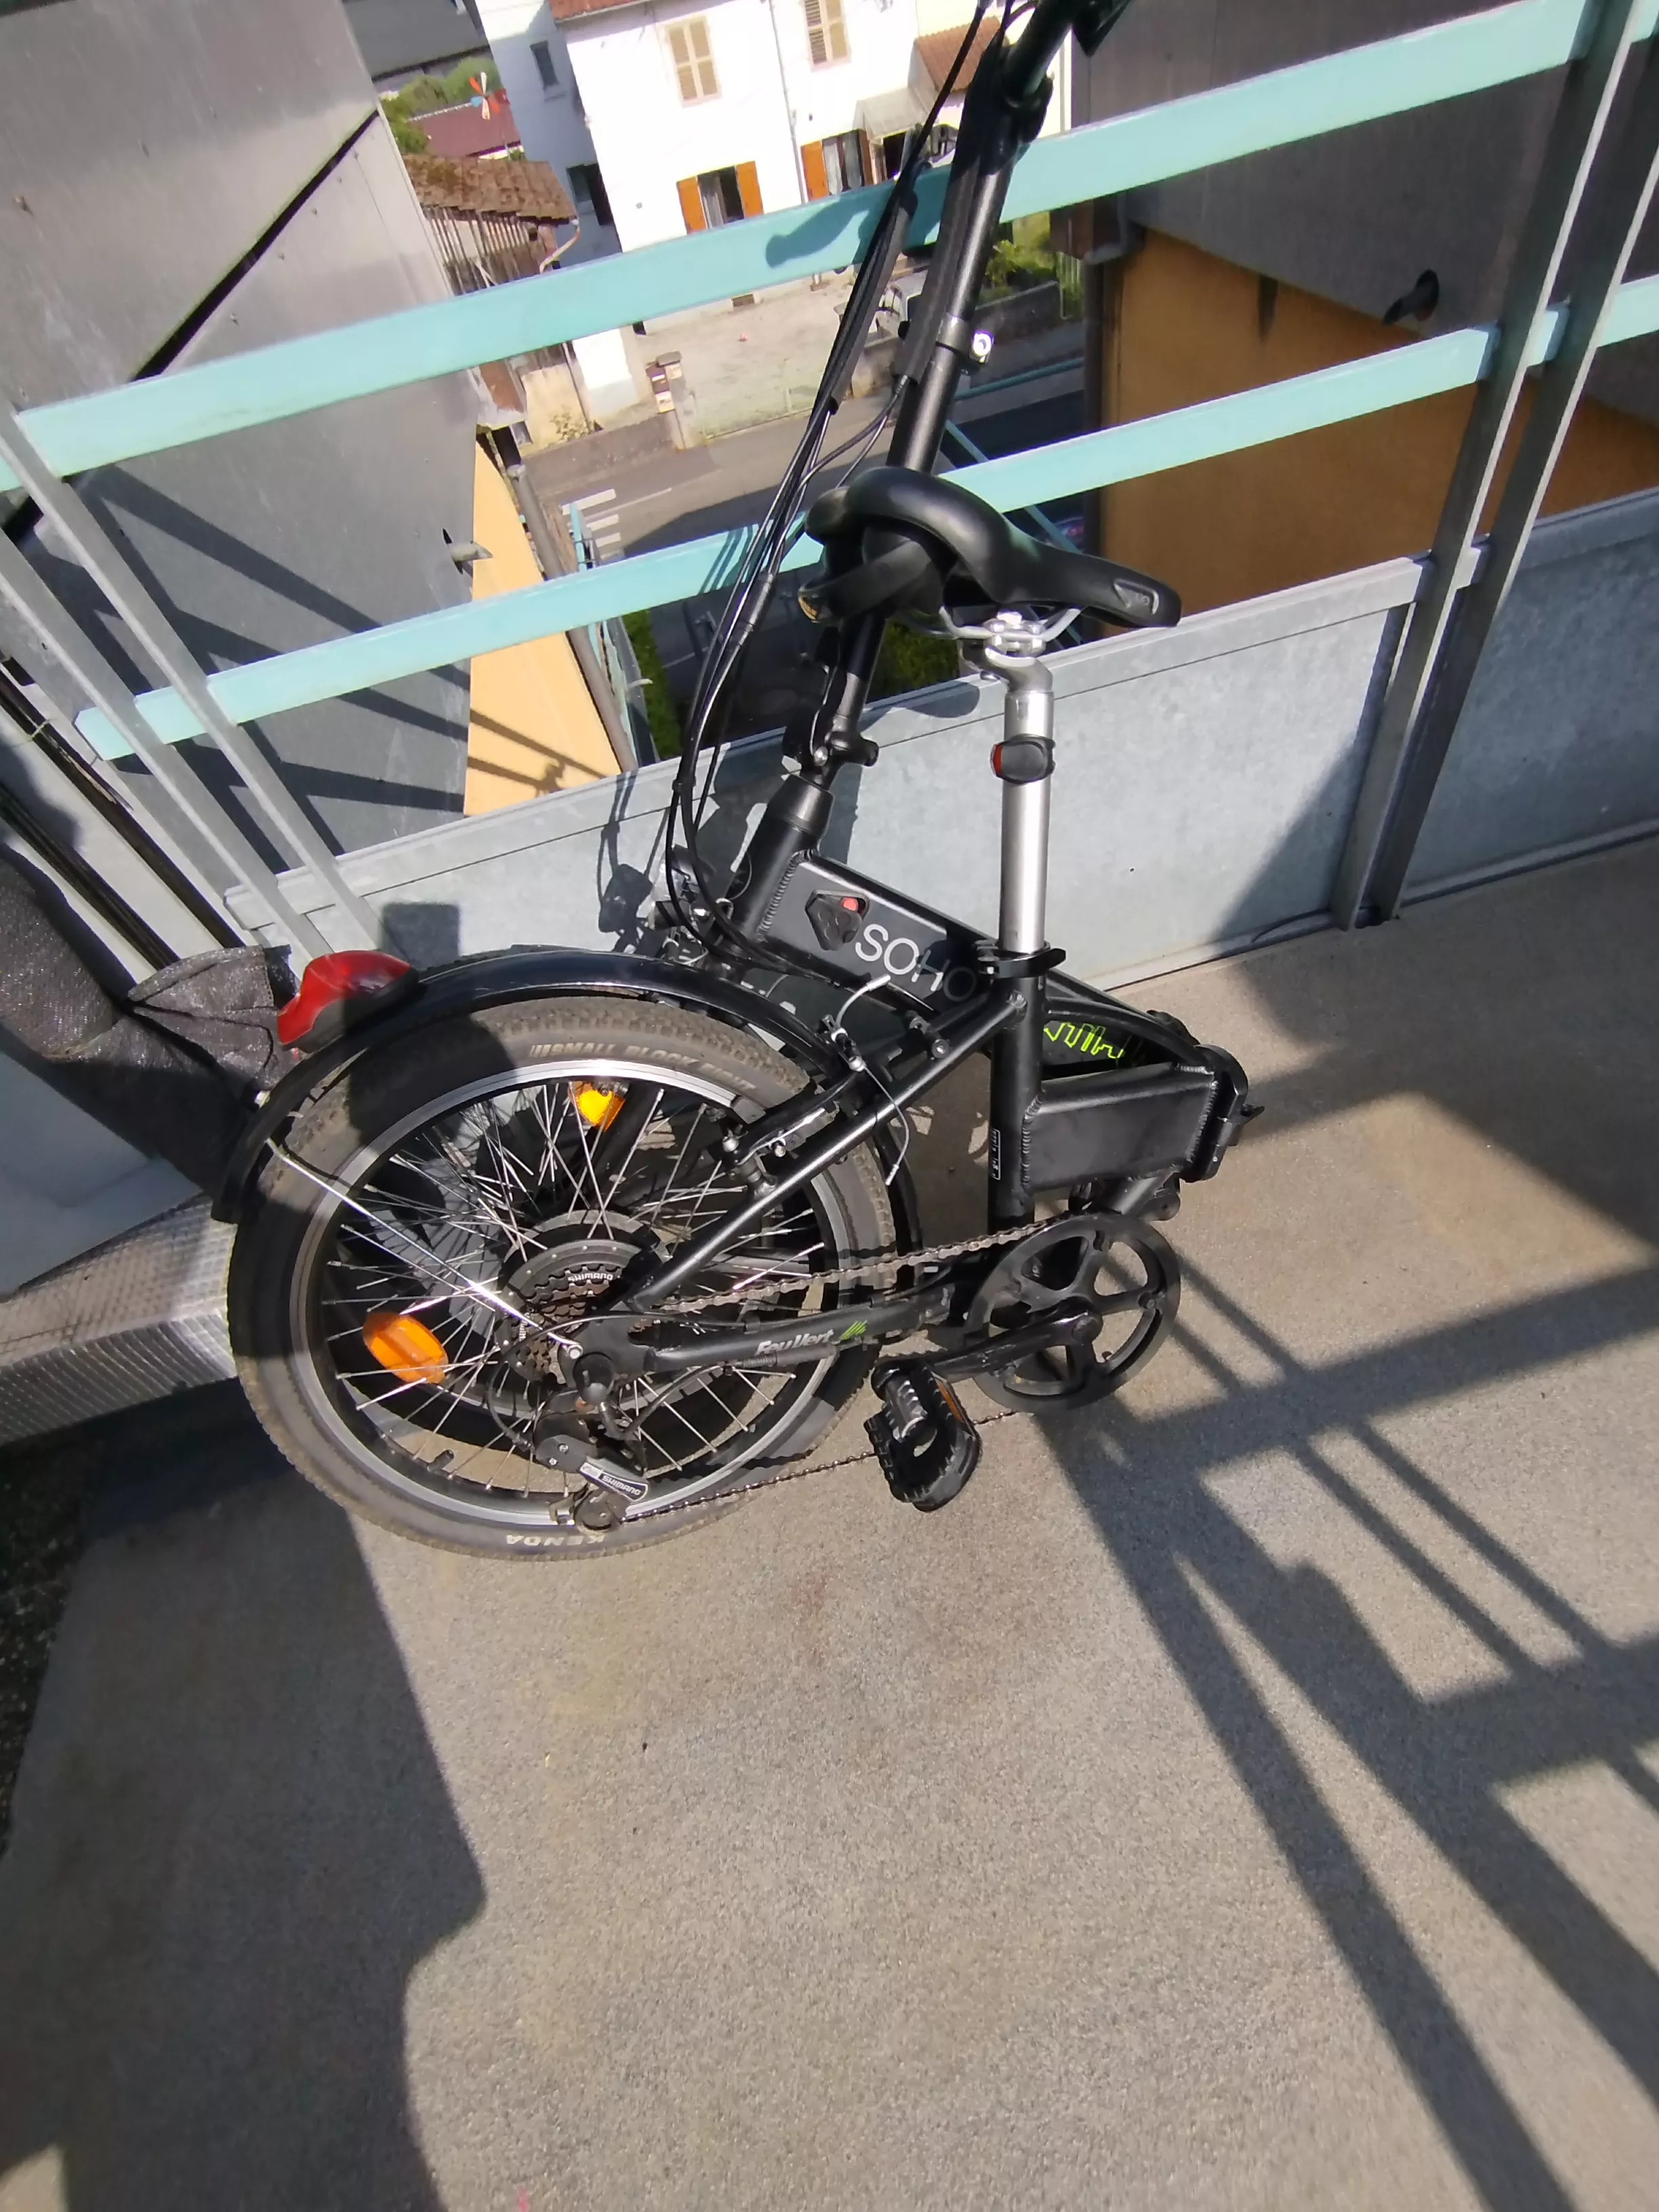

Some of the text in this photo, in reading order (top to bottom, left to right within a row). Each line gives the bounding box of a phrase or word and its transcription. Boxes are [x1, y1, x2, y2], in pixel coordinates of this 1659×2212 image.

[855, 924, 977, 1002] SOHO
[625, 1044, 699, 1065] BLOCK
[568, 1273, 613, 1282] SHIMANO
[602, 1475, 642, 1496] SHIMANO
[506, 1534, 605, 1547] KENDA
